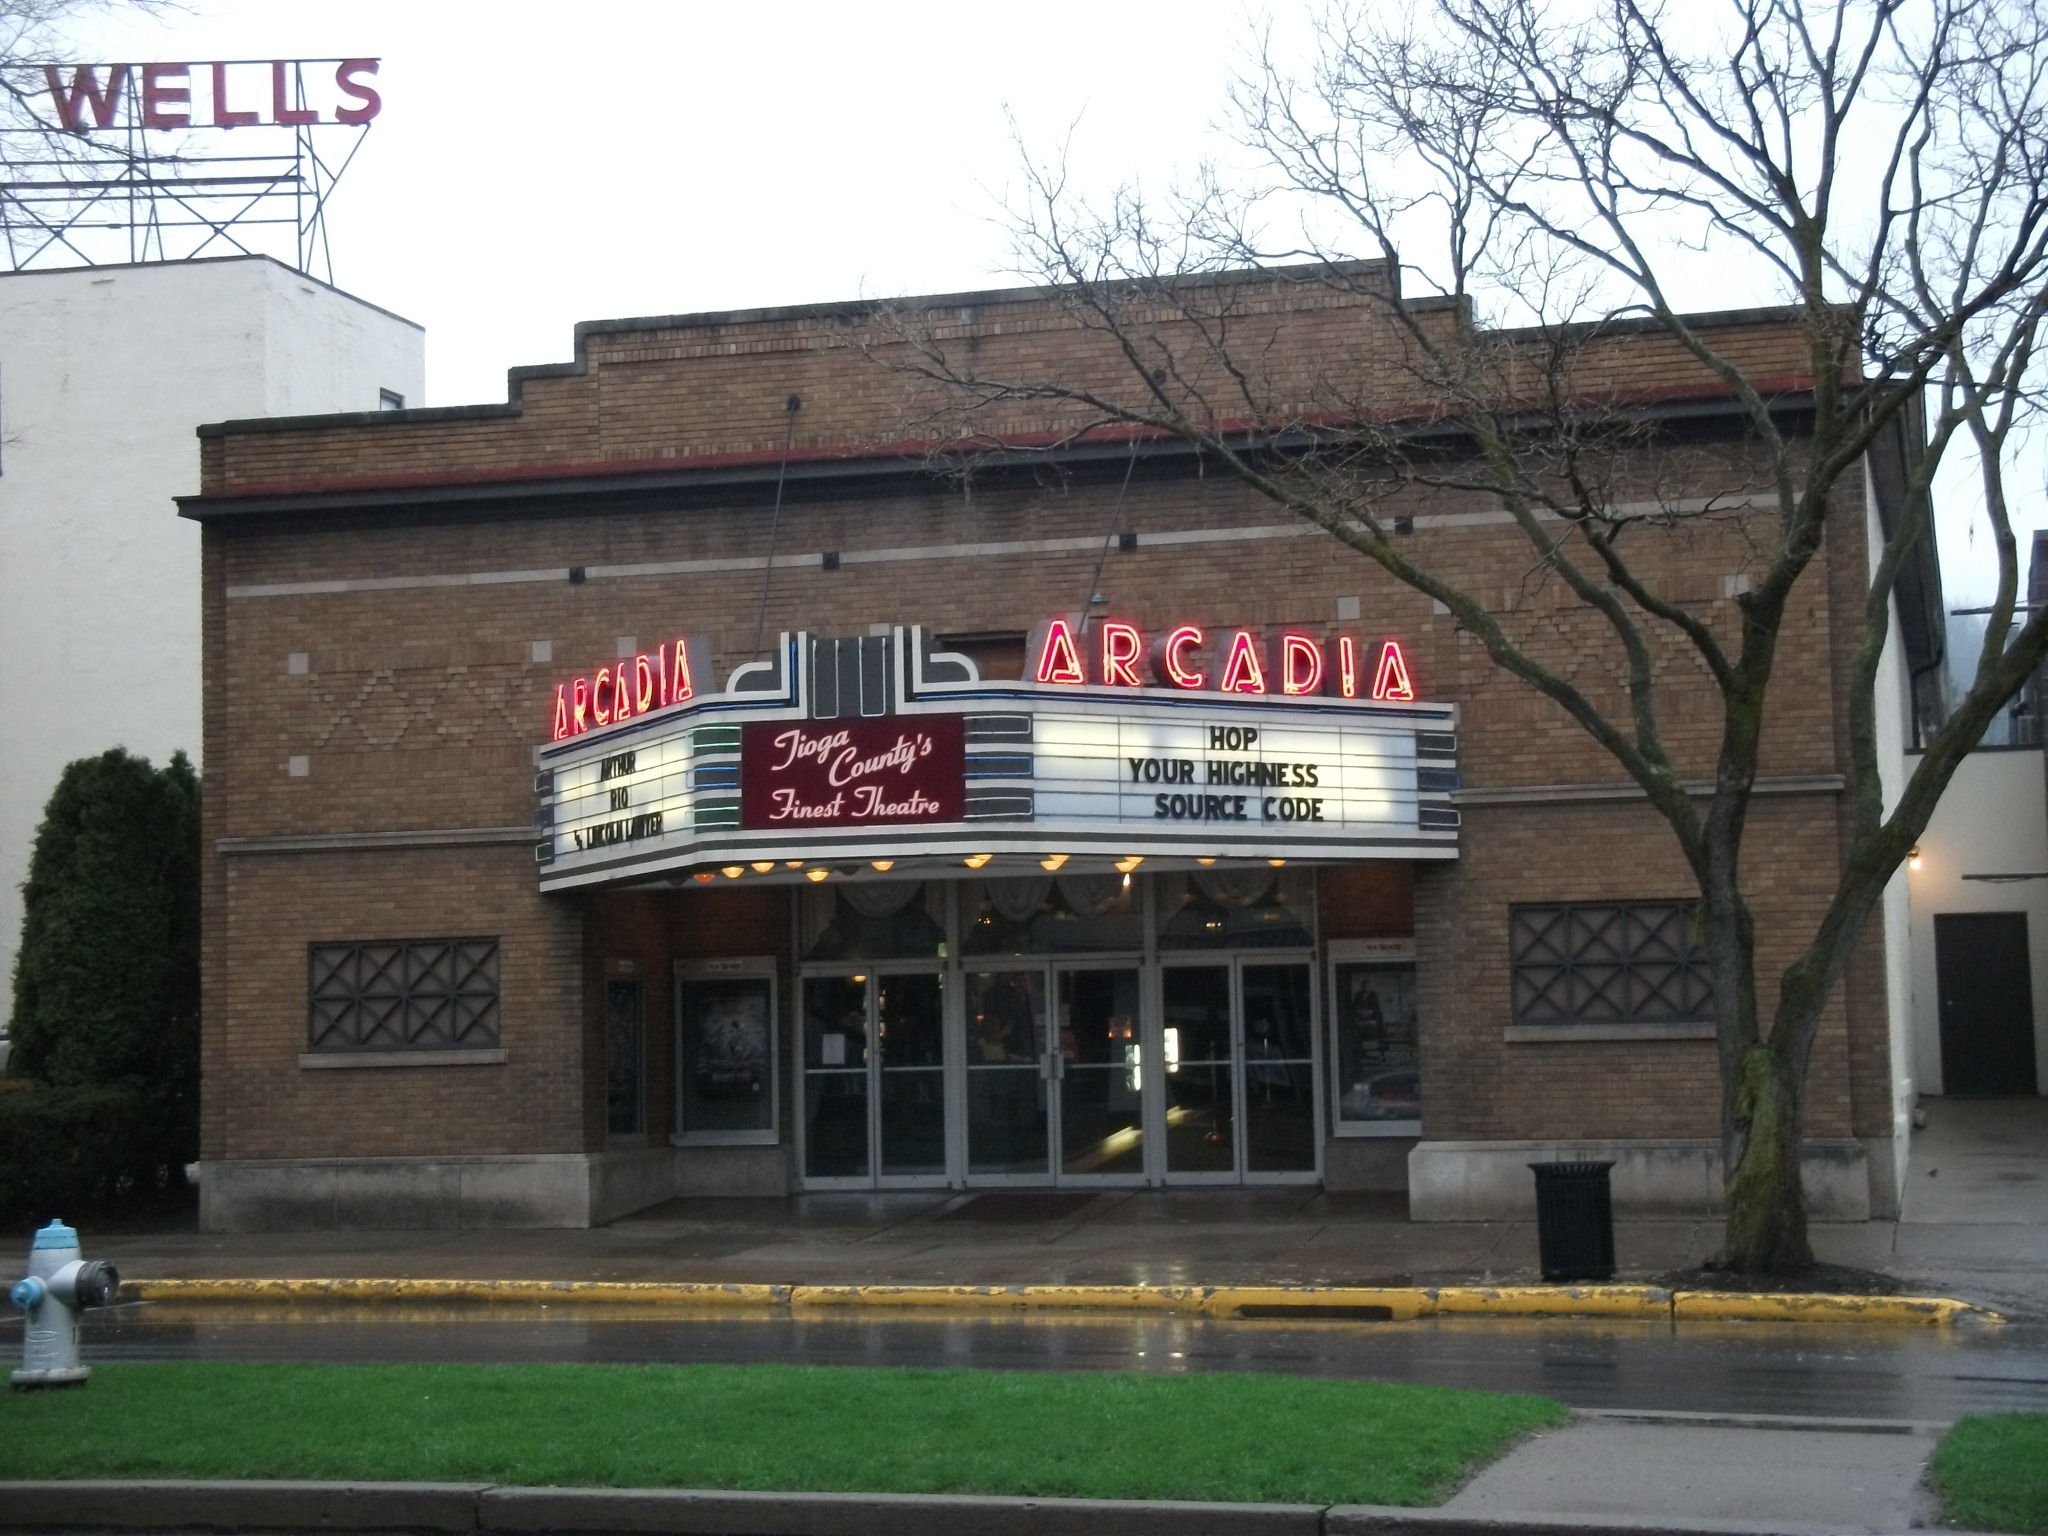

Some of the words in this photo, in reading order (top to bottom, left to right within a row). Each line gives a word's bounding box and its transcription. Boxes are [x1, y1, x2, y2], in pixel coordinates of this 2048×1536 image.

[43, 59, 382, 130] WELLS
[1037, 620, 1414, 700] ARCADIA
[553, 639, 693, 740] ARCADIA
[771, 729, 849, 771] Tioga
[1209, 725, 1258, 752] HOP
[600, 751, 636, 782] ARTHUR
[828, 733, 932, 787] County's
[1129, 757, 1194, 784] YOUR
[1207, 760, 1319, 787] HIGHNESS
[610, 786, 629, 812] RIO
[769, 788, 846, 820] Finest
[850, 785, 940, 817] Theatre
[1154, 793, 1248, 820] SOURCE
[1261, 795, 1324, 822] CODE
